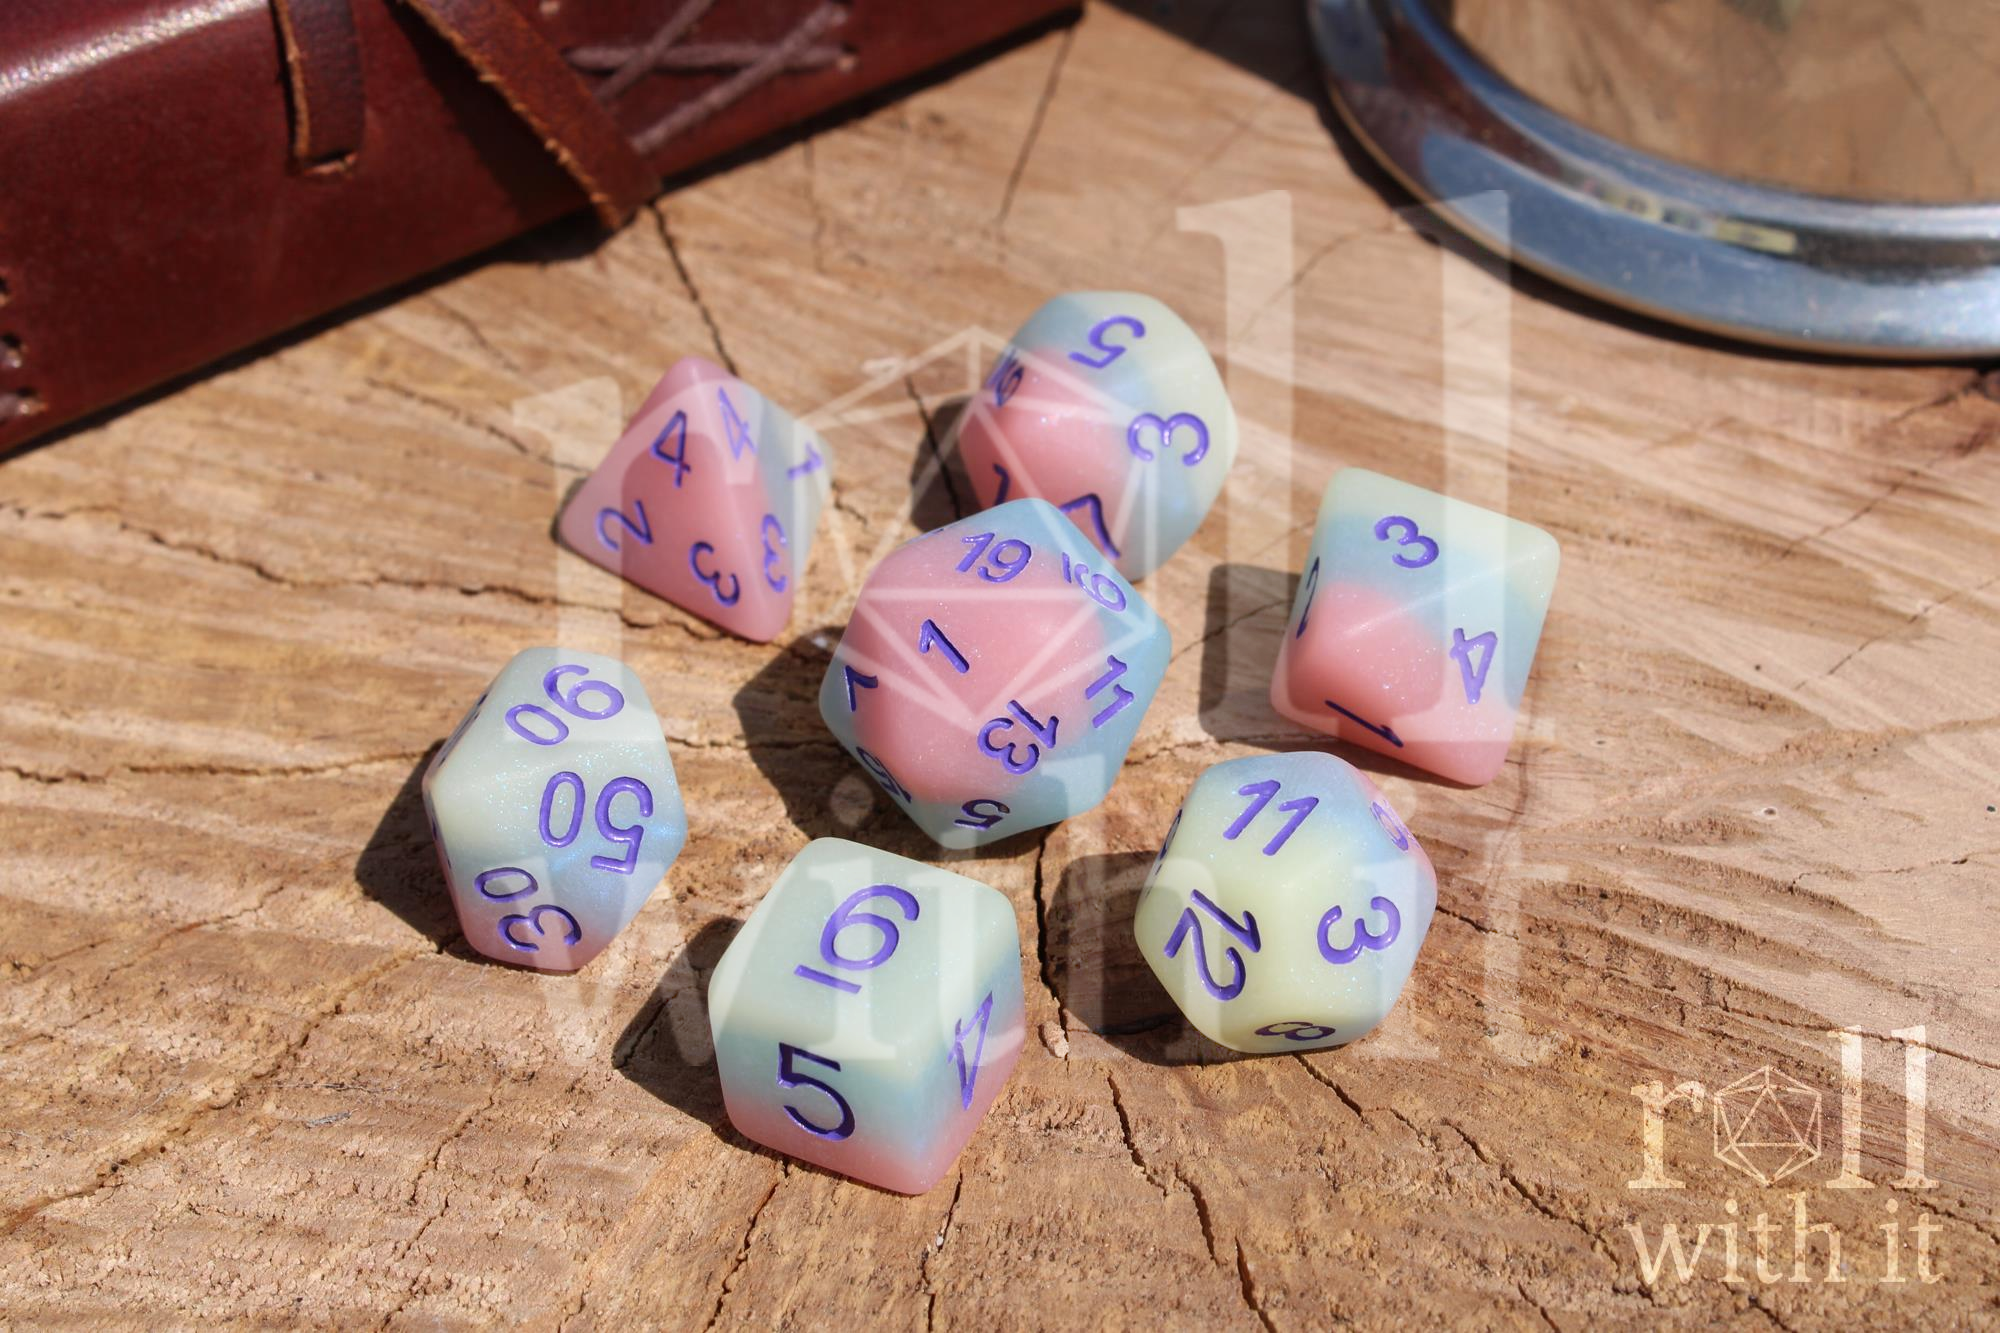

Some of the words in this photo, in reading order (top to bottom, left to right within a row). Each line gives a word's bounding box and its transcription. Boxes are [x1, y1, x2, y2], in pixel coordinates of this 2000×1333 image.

[1068, 316, 1146, 369] 5
[652, 409, 691, 488] 4
[718, 386, 757, 462] 4
[1127, 413, 1209, 466] 3
[786, 441, 824, 482] 1
[595, 500, 654, 551] 2
[761, 514, 787, 593] 3
[954, 532, 1032, 583] 19
[1058, 492, 1120, 558] 7
[1374, 516, 1440, 569] 3
[688, 541, 740, 607] 3
[918, 618, 970, 673] 1
[1449, 627, 1498, 705] 4
[1084, 654, 1135, 728] 11
[976, 699, 1060, 776] 13
[538, 771, 654, 875] 50
[954, 798, 1011, 831] 5
[1222, 780, 1319, 856] 11
[474, 866, 582, 951] 30
[793, 884, 920, 994] 6
[1163, 889, 1262, 1002] 12
[1316, 896, 1401, 965] 3
[947, 990, 994, 1111] 4
[1253, 1020, 1336, 1042] 8
[775, 1042, 856, 1141] 5
